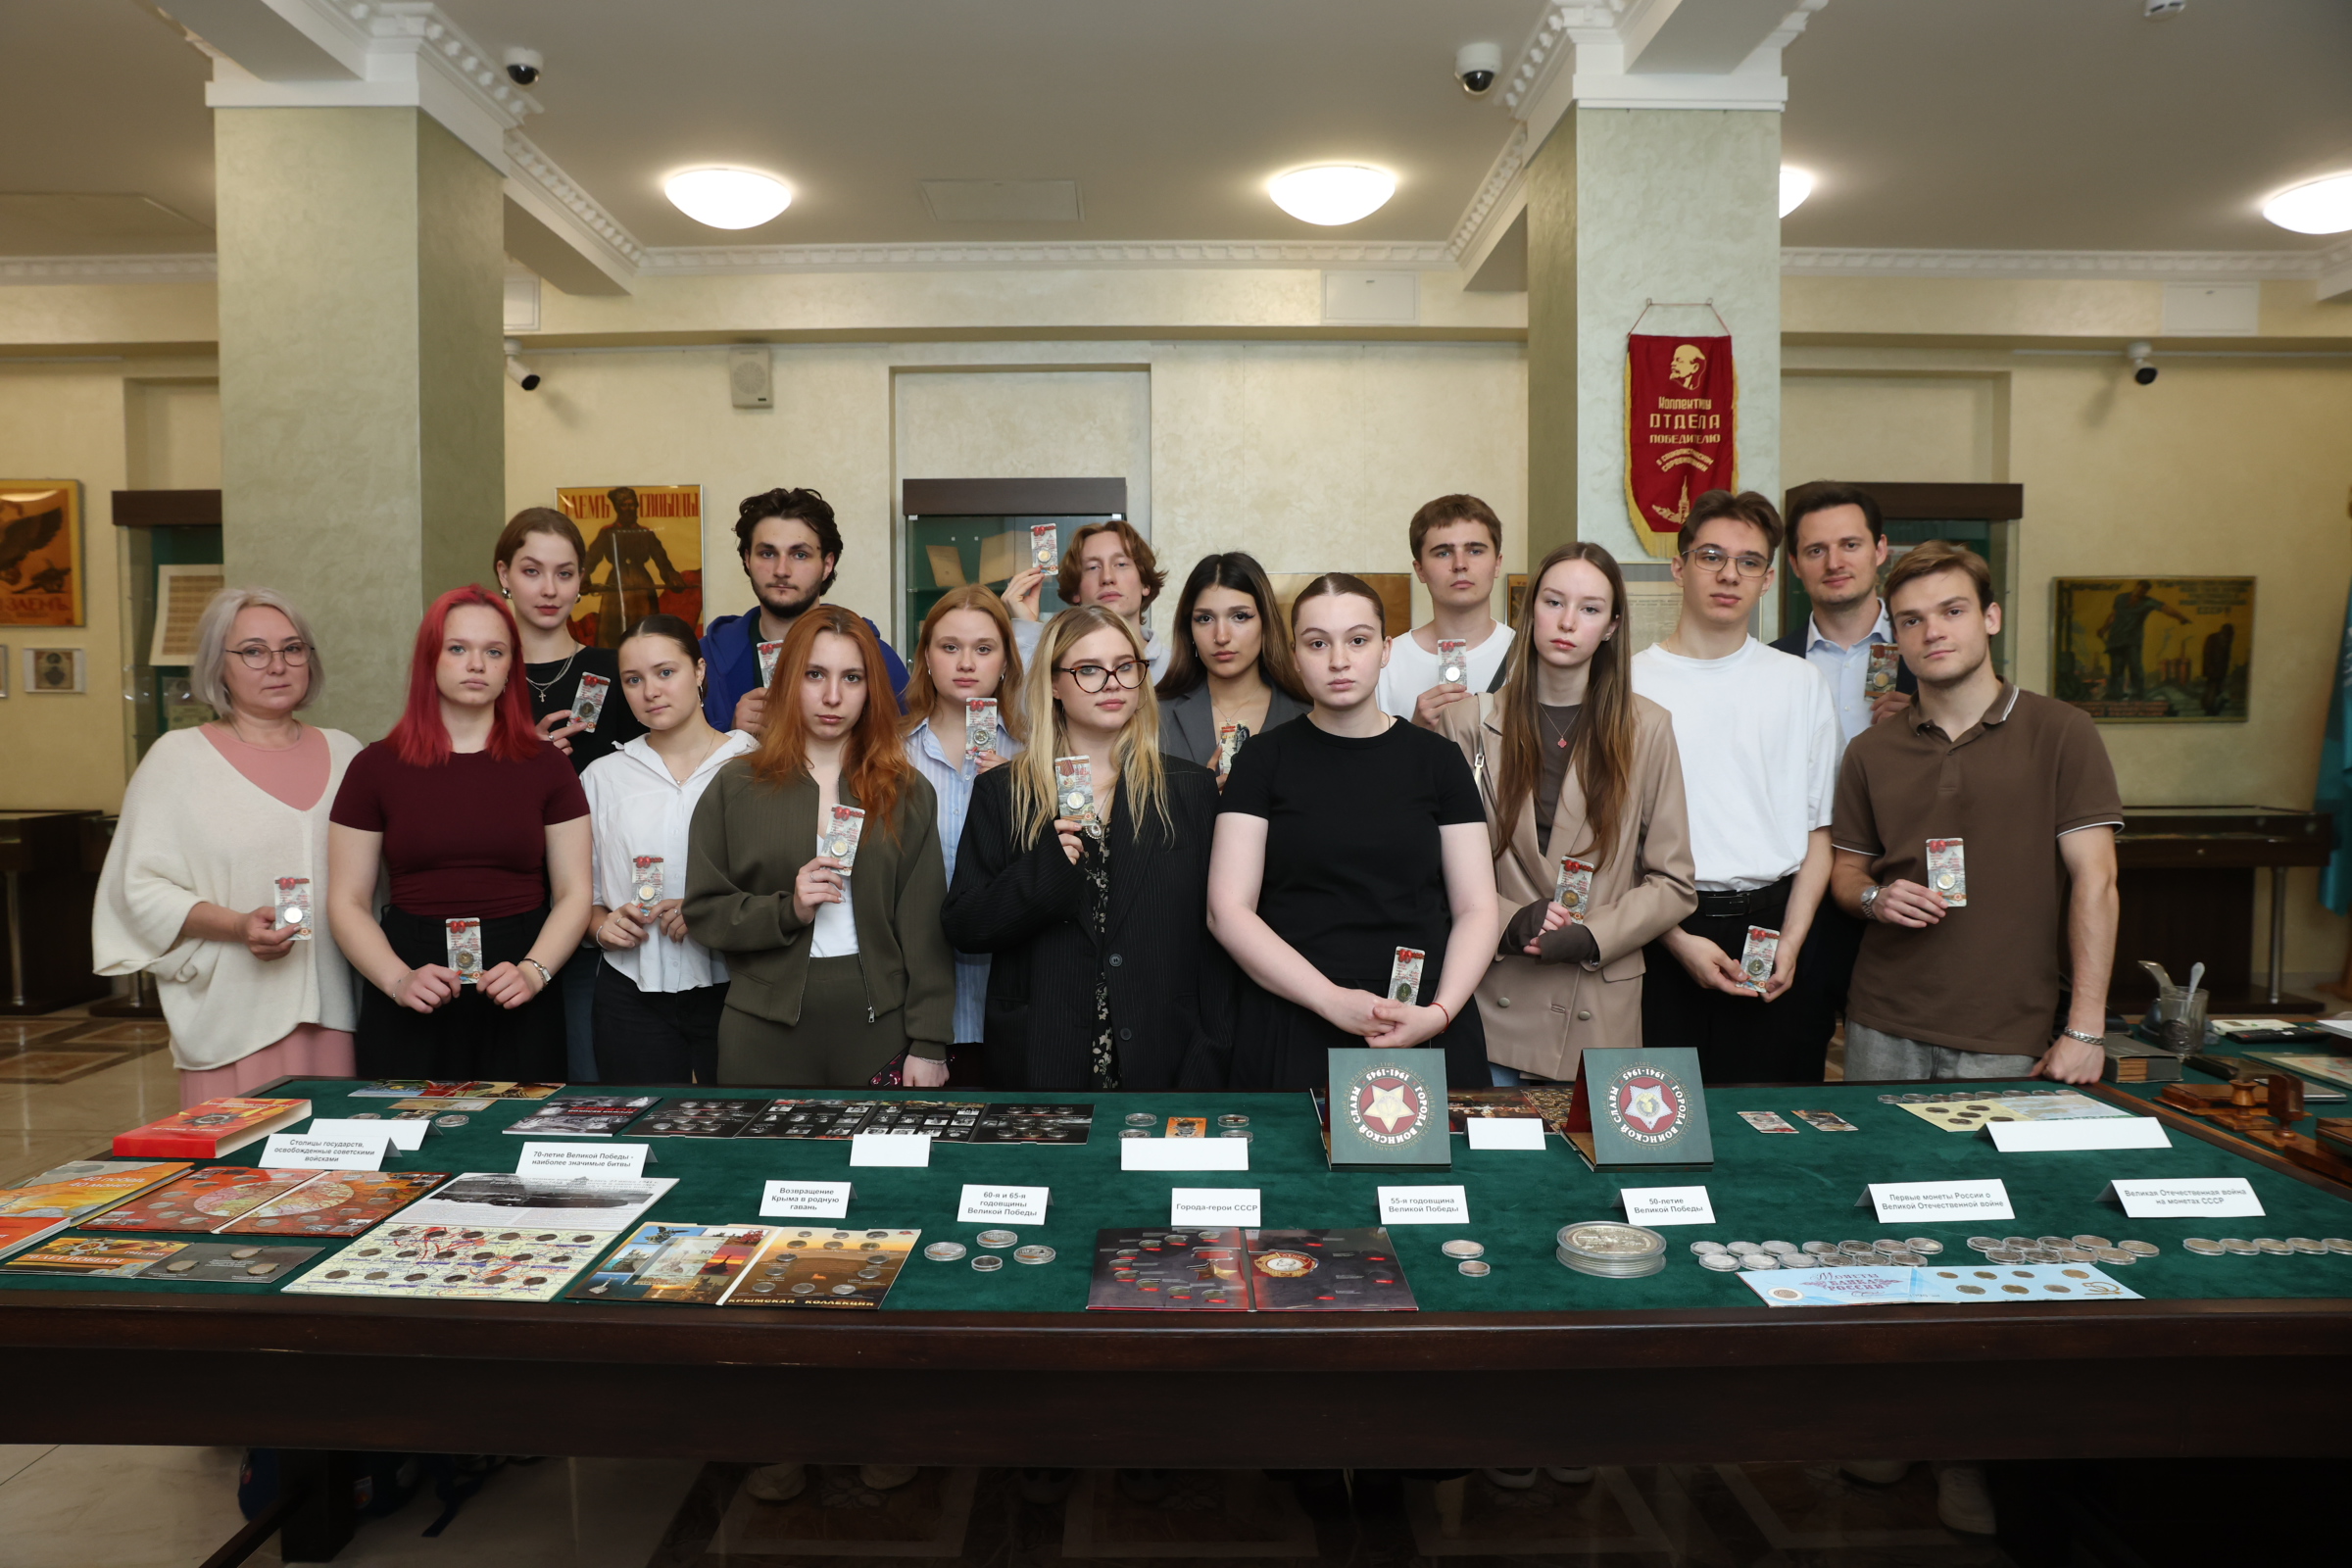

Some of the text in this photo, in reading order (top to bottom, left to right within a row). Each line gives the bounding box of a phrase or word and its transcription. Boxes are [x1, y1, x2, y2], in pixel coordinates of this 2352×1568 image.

[1649, 413, 1720, 429] ОТДЕЛА
[1649, 433, 1721, 444] ПОБЕДИТЕЛЮ
[1365, 1068, 1409, 1081] 1941-1945
[1622, 1068, 1665, 1081] 1941-1945
[1349, 1086, 1428, 1145] ГОРОДА ВОИНСКОЙ СЛАВЫ
[1608, 1085, 1687, 1144] ГОРОДА ВОИНСКОЙ СЛАВЫ
[1889, 1194, 1921, 1202] Первые
[967, 1206, 1003, 1215] Великой
[1176, 1203, 1232, 1212] Города-герои
